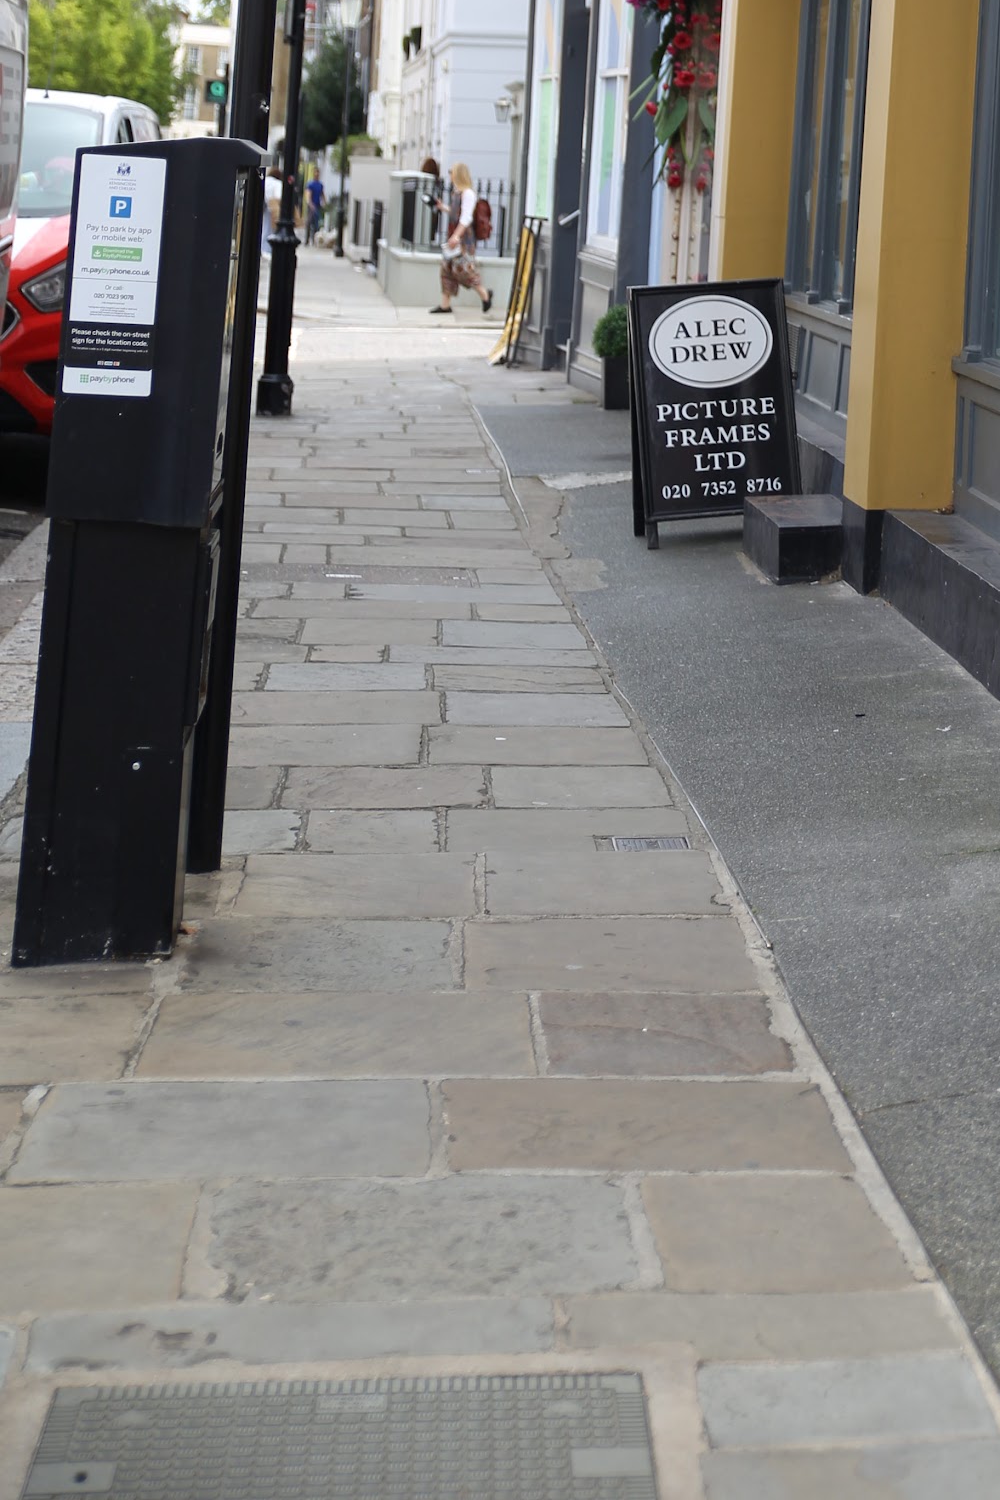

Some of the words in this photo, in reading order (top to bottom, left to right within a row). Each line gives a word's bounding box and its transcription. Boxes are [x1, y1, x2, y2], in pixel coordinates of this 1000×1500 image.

[115, 200, 127, 214] P
[86, 224, 99, 232] Pay
[81, 267, 150, 275] m.paybyphone.co.uk
[673, 317, 747, 339] ALEC
[669, 340, 752, 364] DREW
[90, 376, 134, 384] paybyphone
[656, 397, 776, 422] PICTURE
[664, 423, 771, 449] FRAMES
[694, 450, 746, 472] LTD
[662, 484, 691, 500] 020
[700, 480, 736, 497] 7352
[746, 477, 782, 493] 8716
